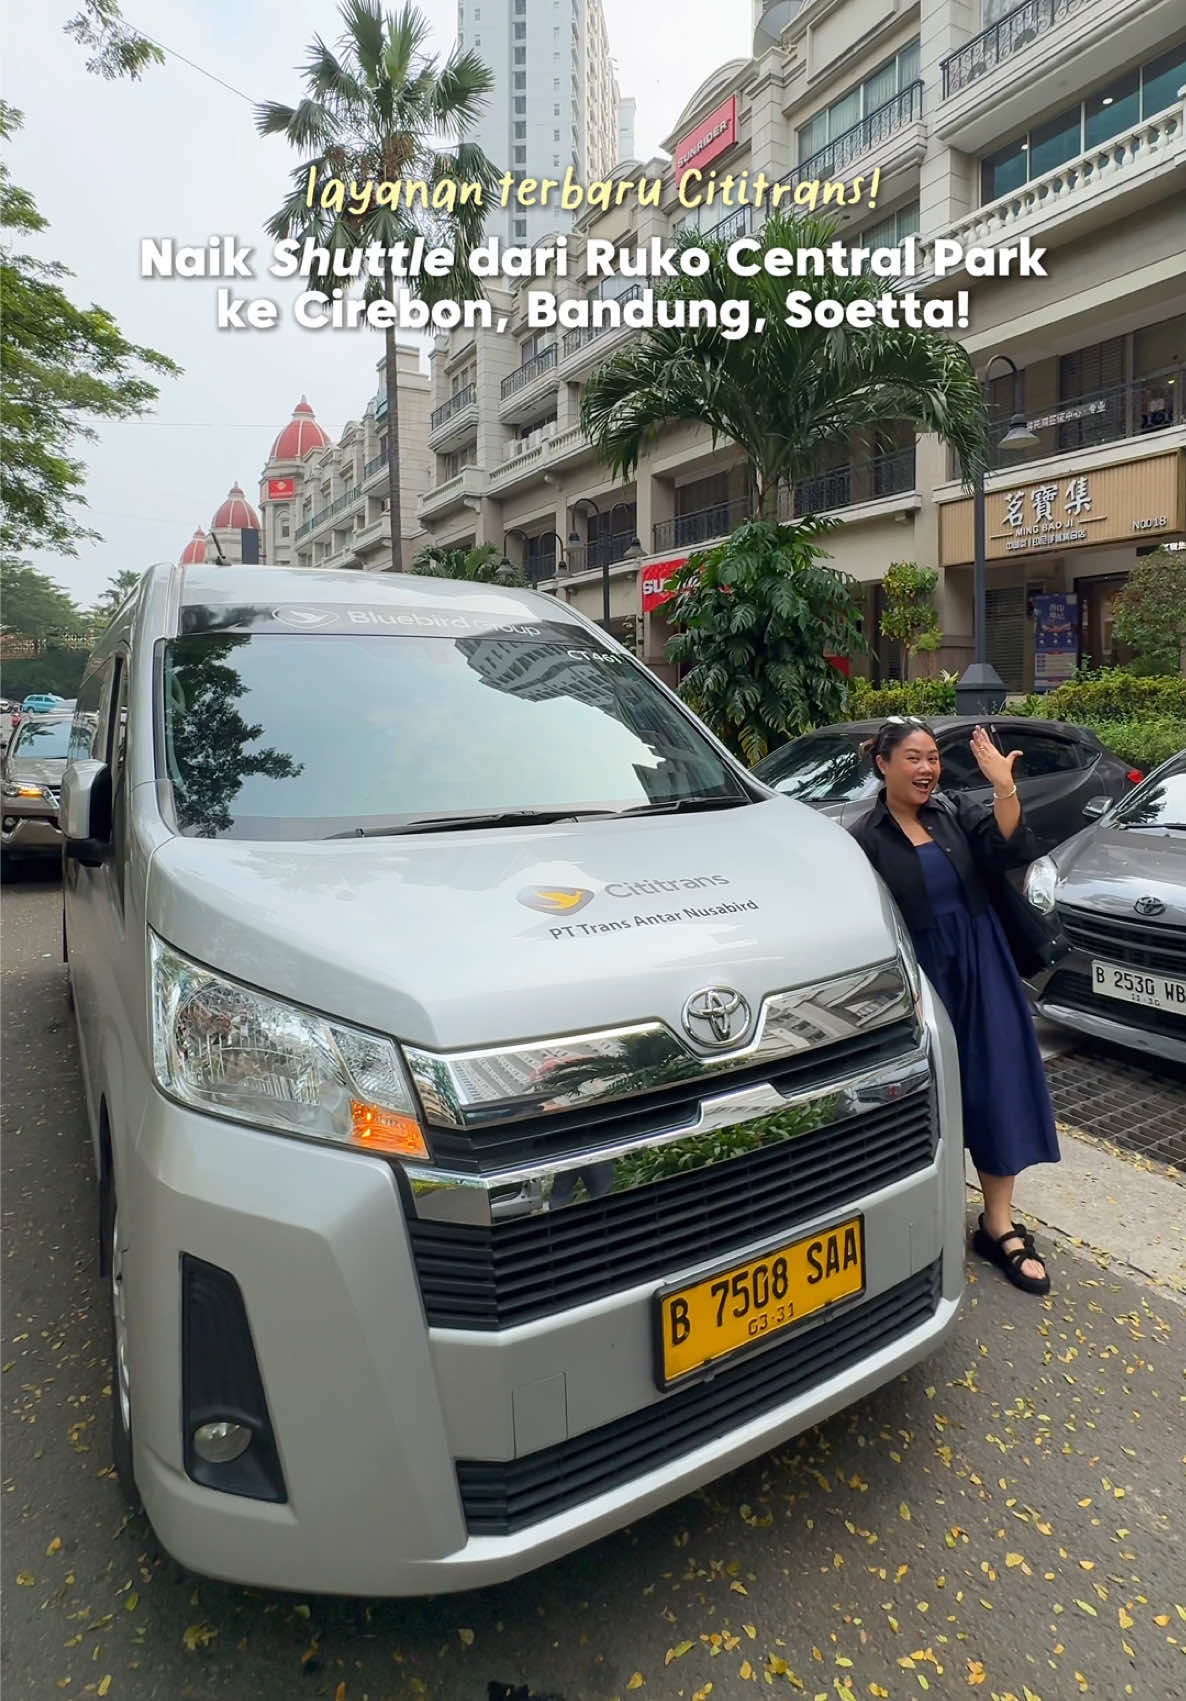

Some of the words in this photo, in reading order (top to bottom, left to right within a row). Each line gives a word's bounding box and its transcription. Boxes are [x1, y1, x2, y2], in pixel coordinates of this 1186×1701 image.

[678, 119, 728, 168] SUNRIDER
[1001, 476, 1092, 527] 茗寶集
[1015, 525, 1040, 537] MING
[348, 609, 471, 630] Bluebird
[472, 618, 541, 637] Group
[604, 873, 729, 899] Cititrans
[549, 926, 576, 940] PT
[577, 919, 632, 937] Trans
[633, 911, 683, 928] Antar
[684, 899, 759, 920] Nusabird
[1096, 966, 1105, 983] B
[1114, 970, 1155, 995] 2530
[670, 1297, 691, 1346] B
[711, 1257, 788, 1328] 7508
[807, 1227, 858, 1285] SAA
